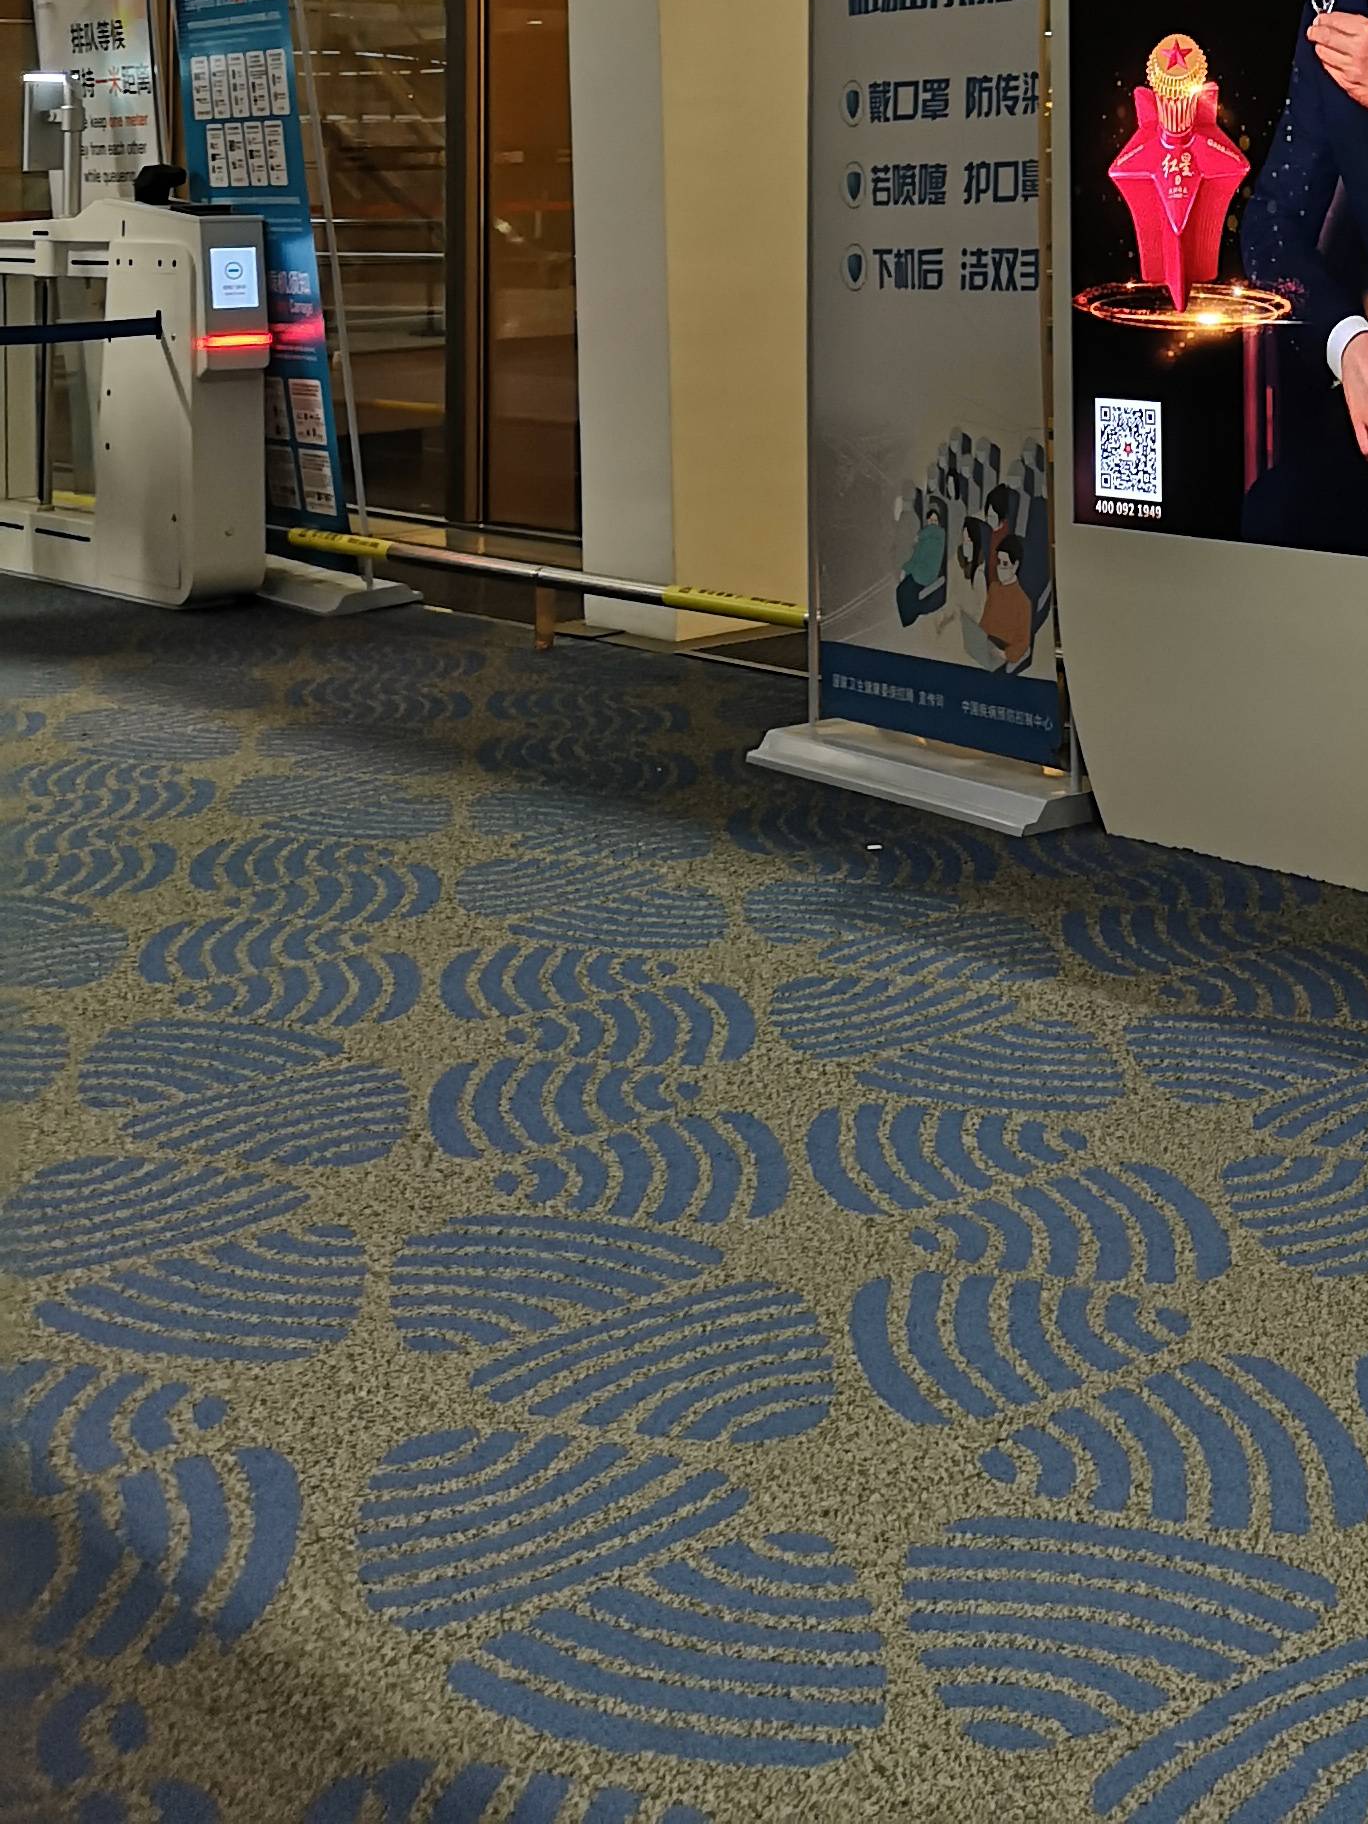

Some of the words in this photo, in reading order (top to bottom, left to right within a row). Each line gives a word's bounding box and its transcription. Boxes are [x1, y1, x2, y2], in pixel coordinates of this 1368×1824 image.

[70, 19, 126, 54] 排队等候
[868, 78, 951, 123] 戴口罩
[1161, 151, 1193, 179] 红星
[871, 163, 947, 206] 若喷嚏
[872, 248, 943, 290] 下机后
[1095, 499, 1115, 515] 400
[1116, 501, 1135, 516] 092
[1137, 503, 1162, 520] 1949
